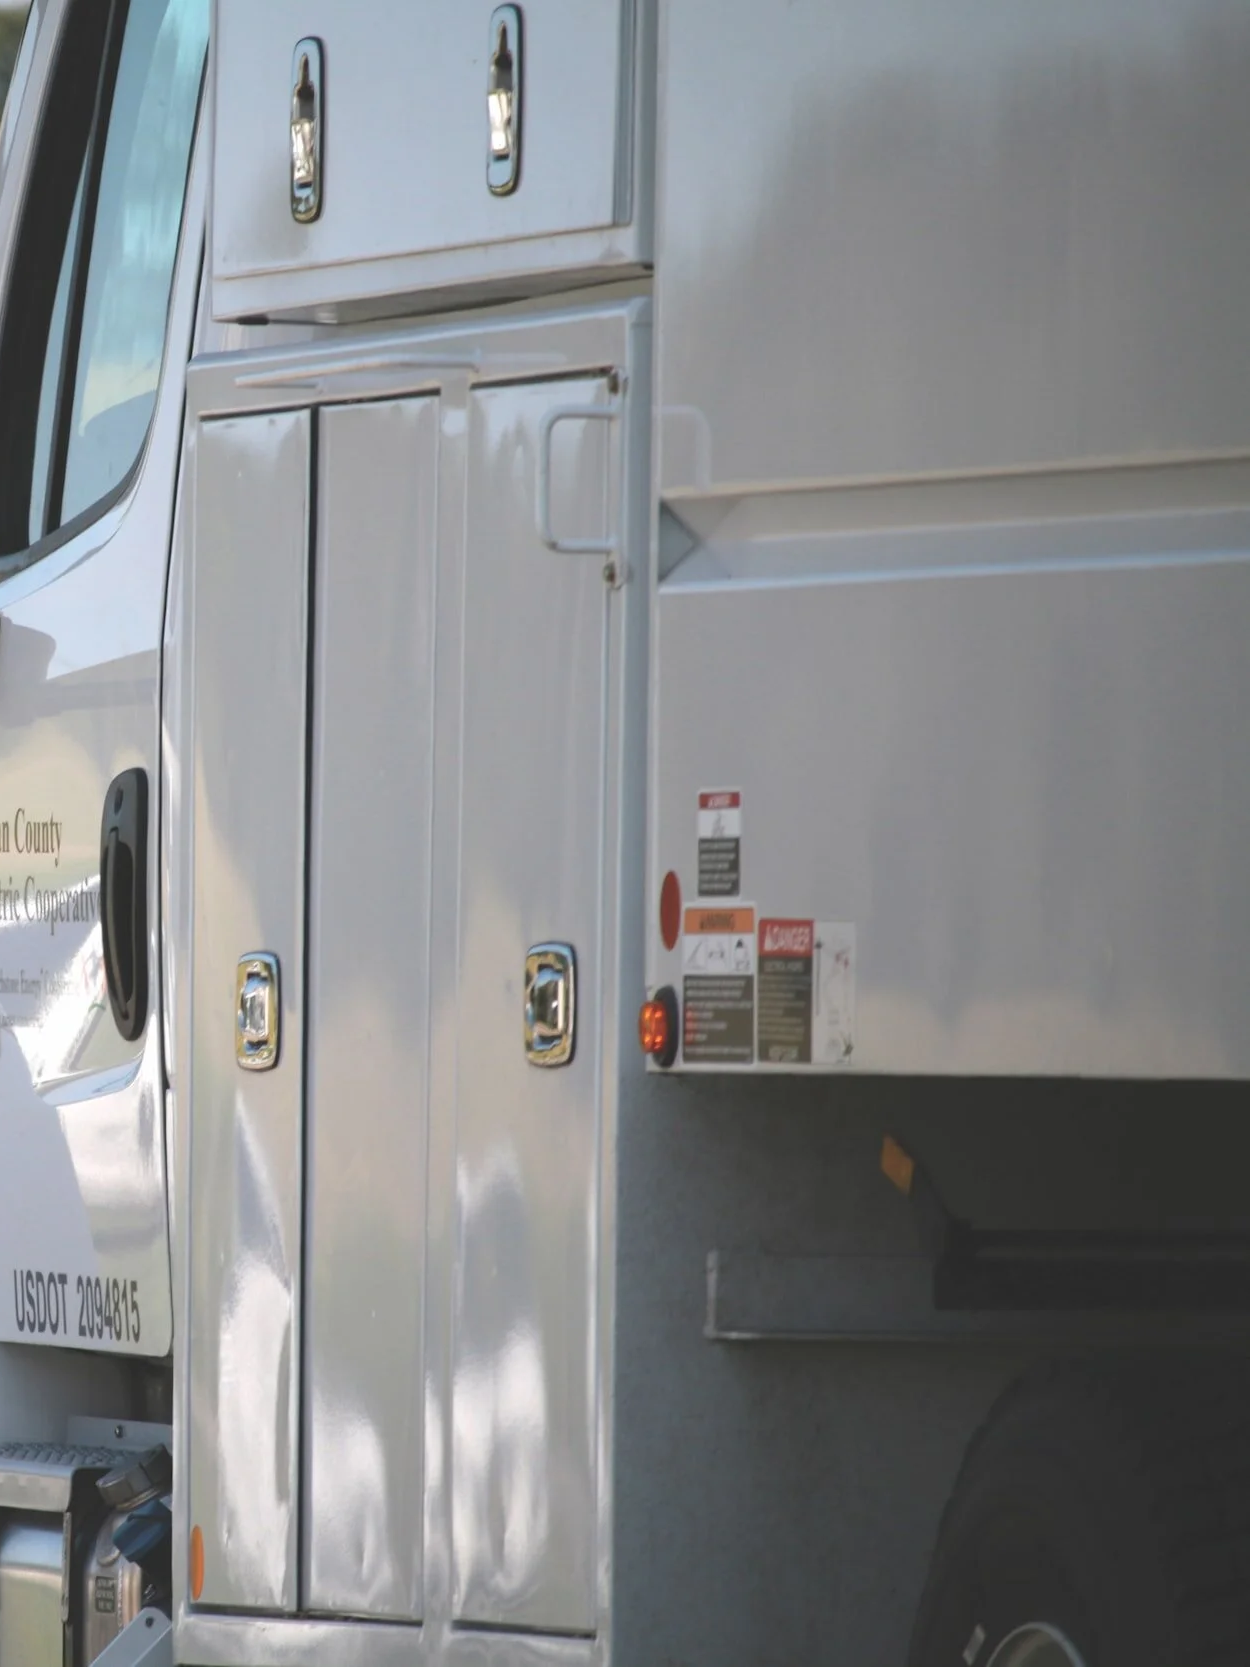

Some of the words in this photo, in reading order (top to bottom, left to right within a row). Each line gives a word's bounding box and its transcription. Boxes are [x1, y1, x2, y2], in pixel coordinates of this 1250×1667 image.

[14, 807, 62, 868] County
[13, 1269, 68, 1335] USDOT
[76, 1274, 141, 1344] 2094815
